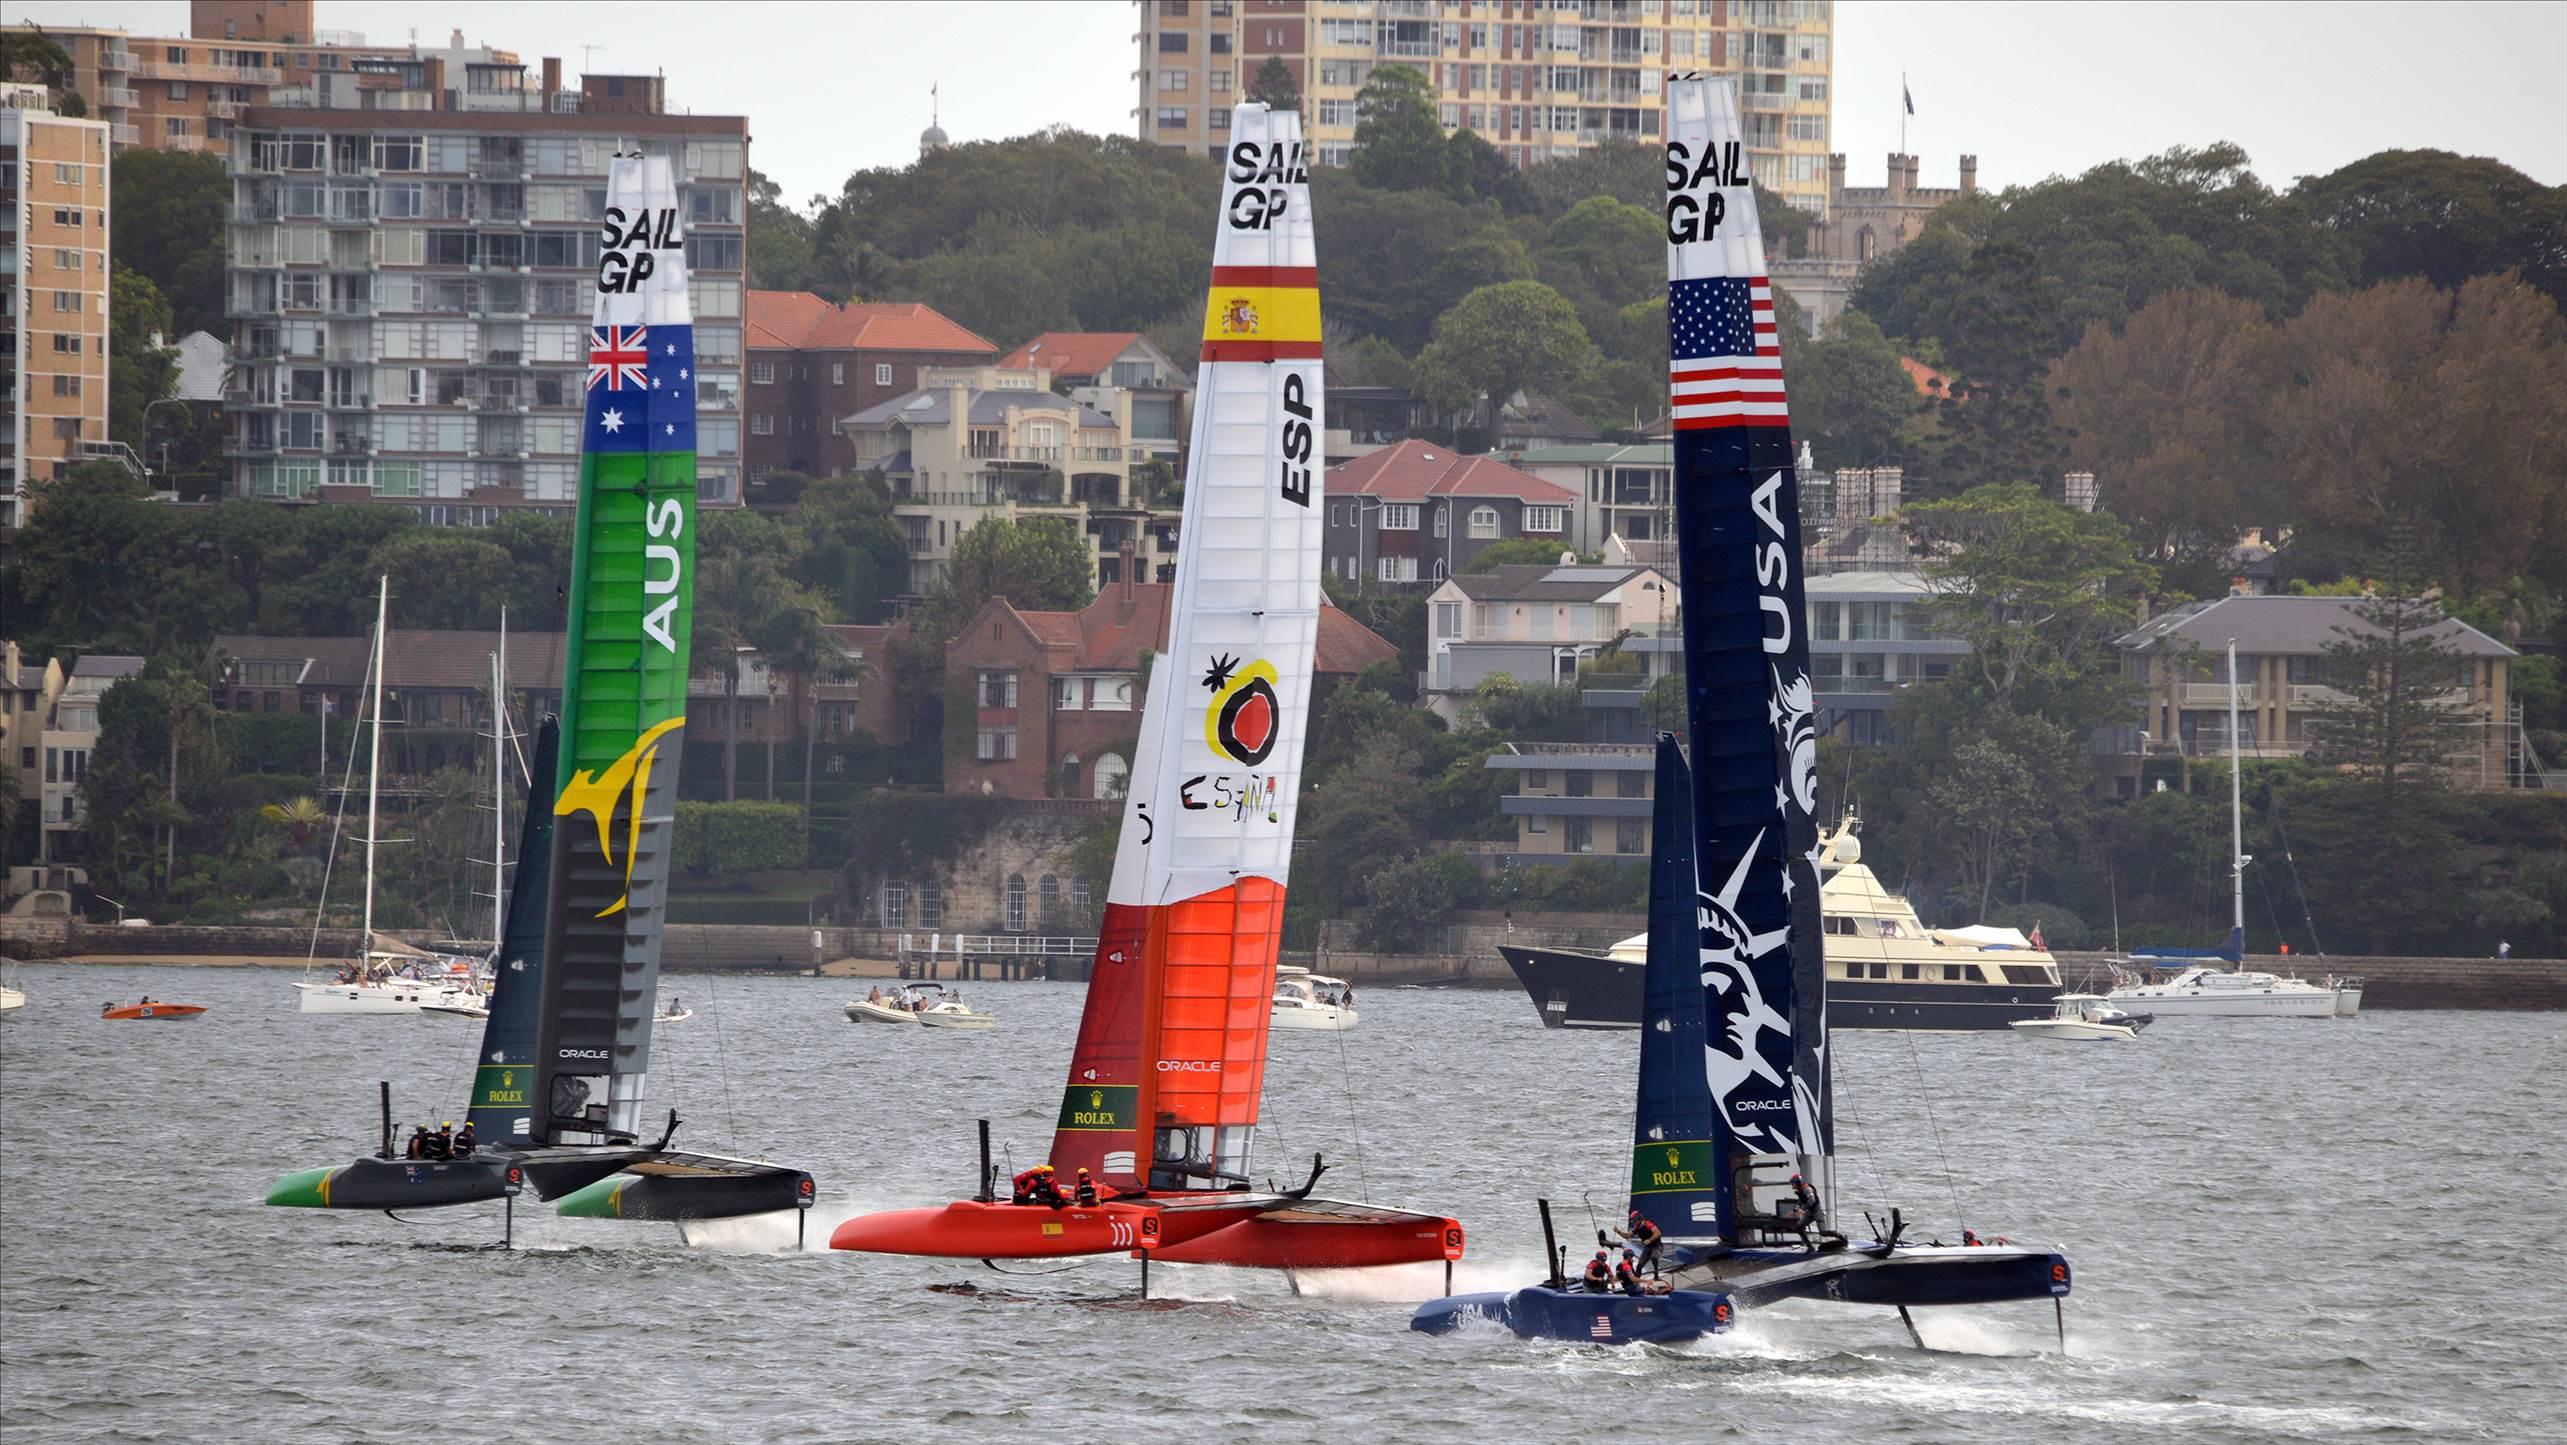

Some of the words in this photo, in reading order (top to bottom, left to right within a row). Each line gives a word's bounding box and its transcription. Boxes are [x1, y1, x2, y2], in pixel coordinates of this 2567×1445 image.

[1228, 142, 1308, 184] SAIL
[1666, 140, 1749, 191] SAIL
[601, 207, 683, 249] SAIL
[1228, 187, 1288, 230] GP
[1667, 192, 1725, 245] GP
[598, 251, 655, 293] GP
[1282, 373, 1313, 508] ESP
[643, 498, 683, 654] AUS
[1751, 470, 1791, 654] USA
[559, 1049, 609, 1059] ORACLE
[1156, 1060, 1221, 1072] ORACLE
[489, 1090, 522, 1102] ROLEX
[1735, 1099, 1792, 1112] ORACLE
[1074, 1111, 1115, 1125] ROLEX
[1653, 1170, 1696, 1186] ROLEX
